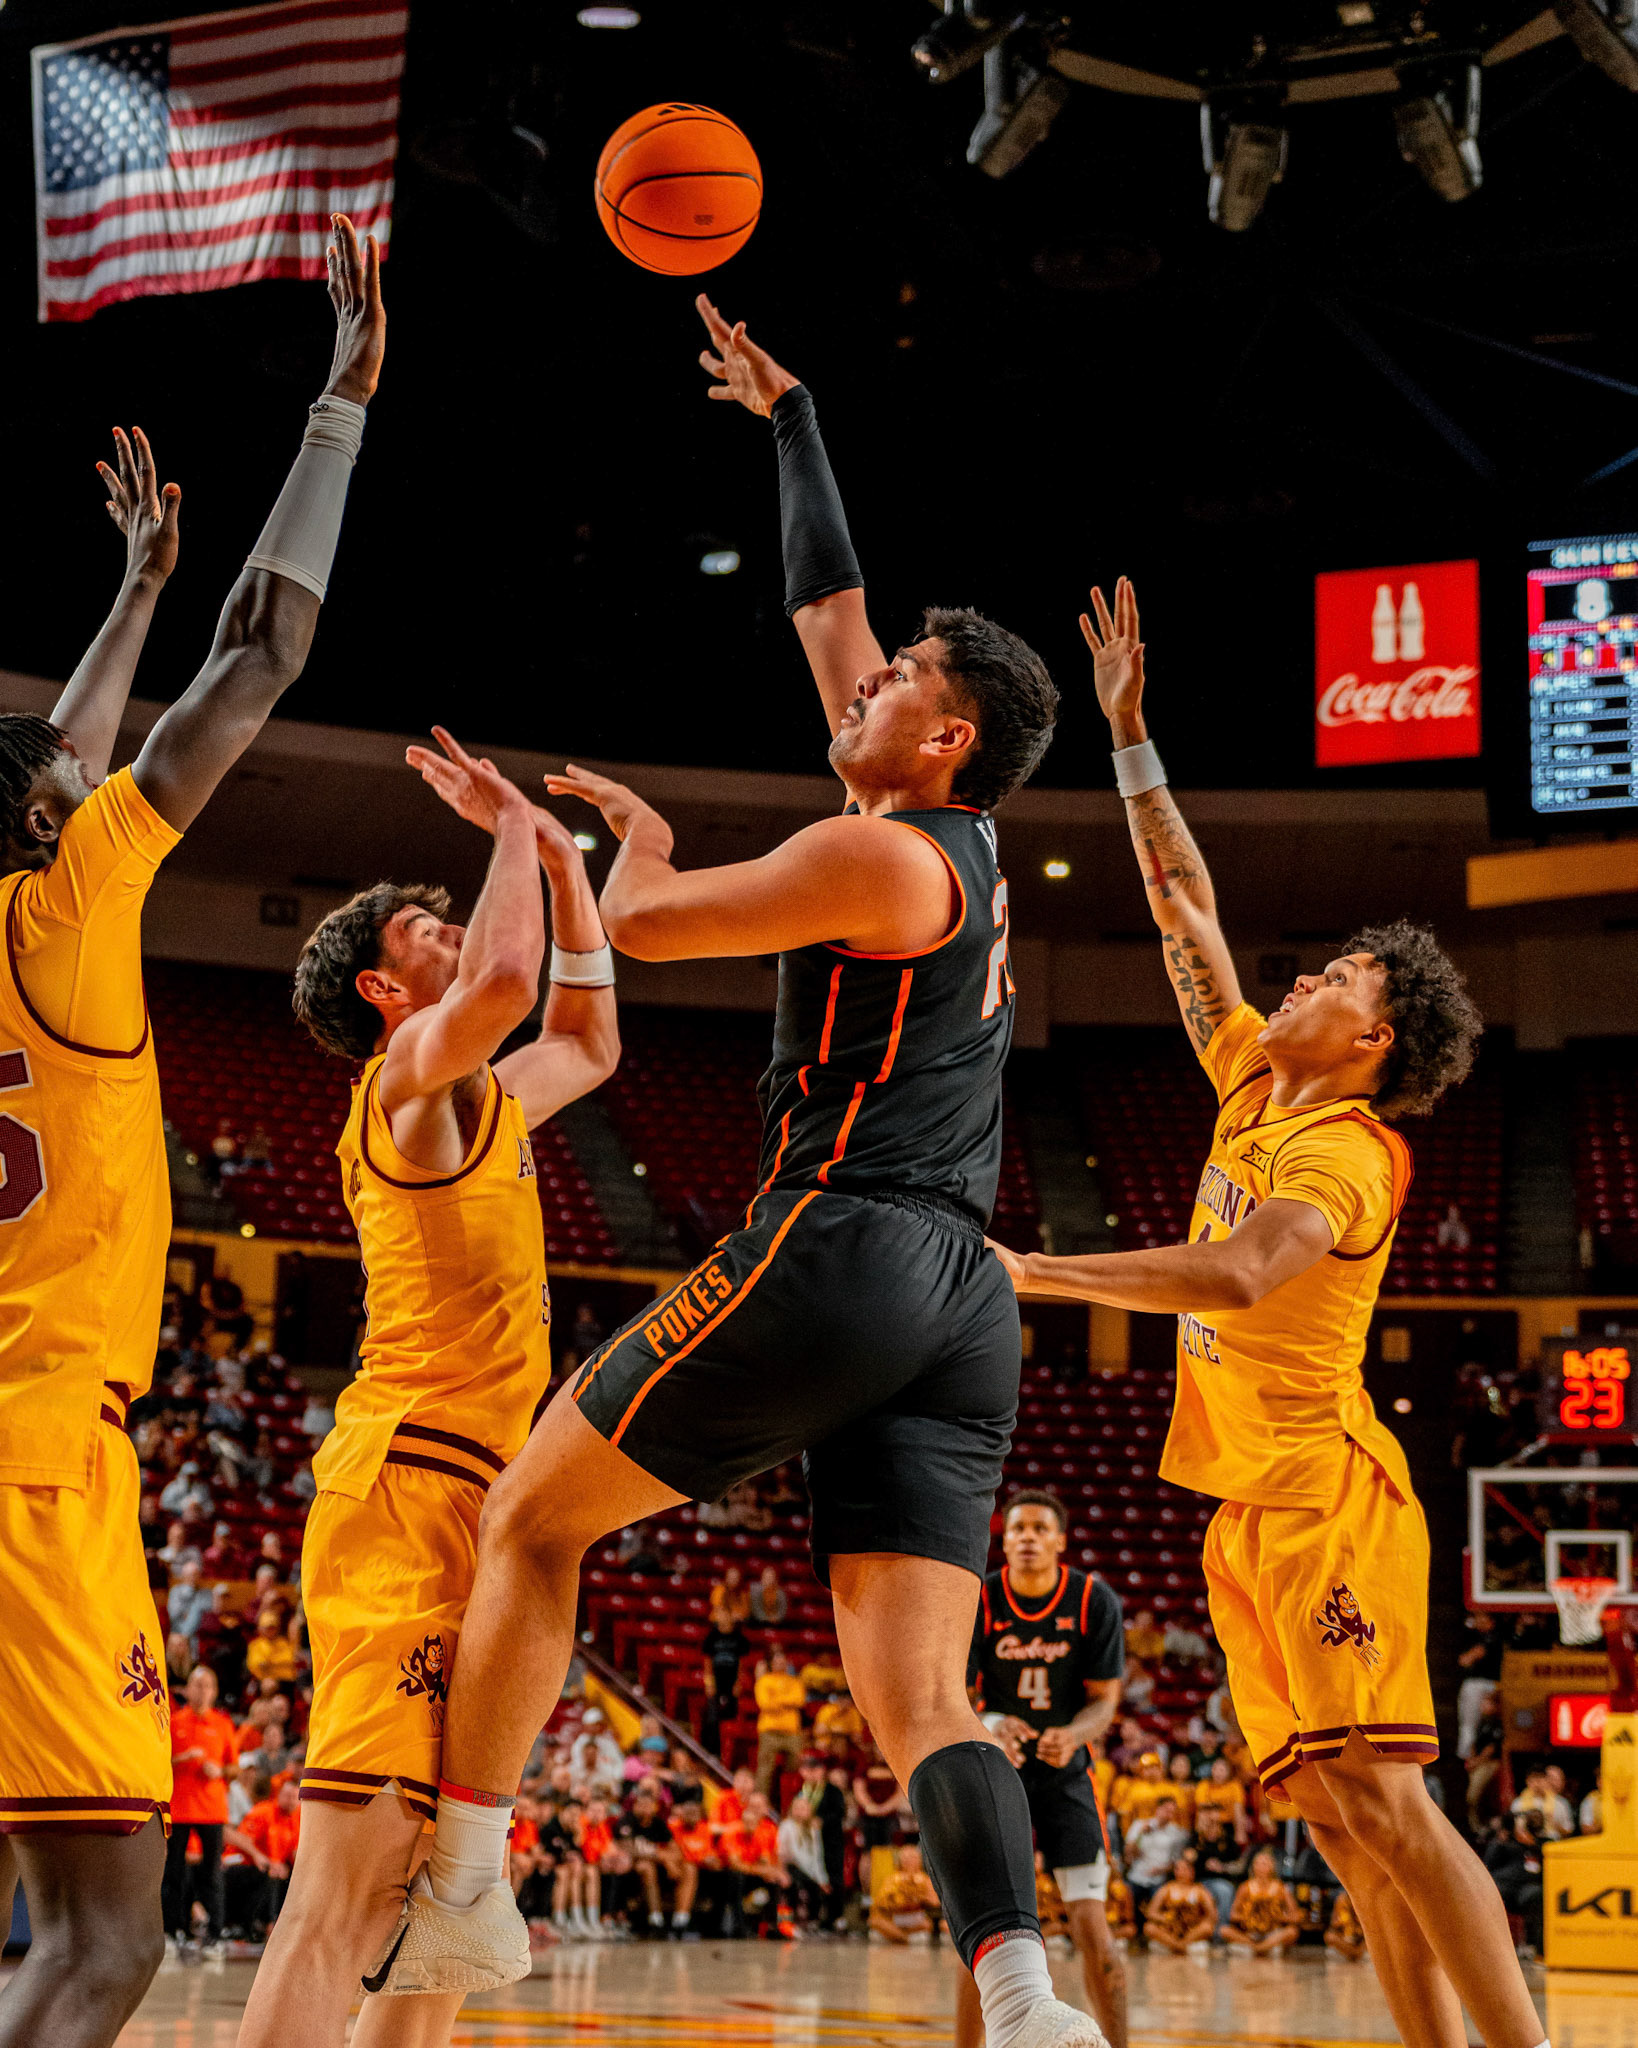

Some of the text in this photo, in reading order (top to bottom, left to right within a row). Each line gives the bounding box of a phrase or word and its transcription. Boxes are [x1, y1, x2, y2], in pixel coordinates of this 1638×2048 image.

[643, 1264, 733, 1358] POKES
[1560, 1378, 1625, 1429] 23
[1017, 1666, 1051, 1711] 4
